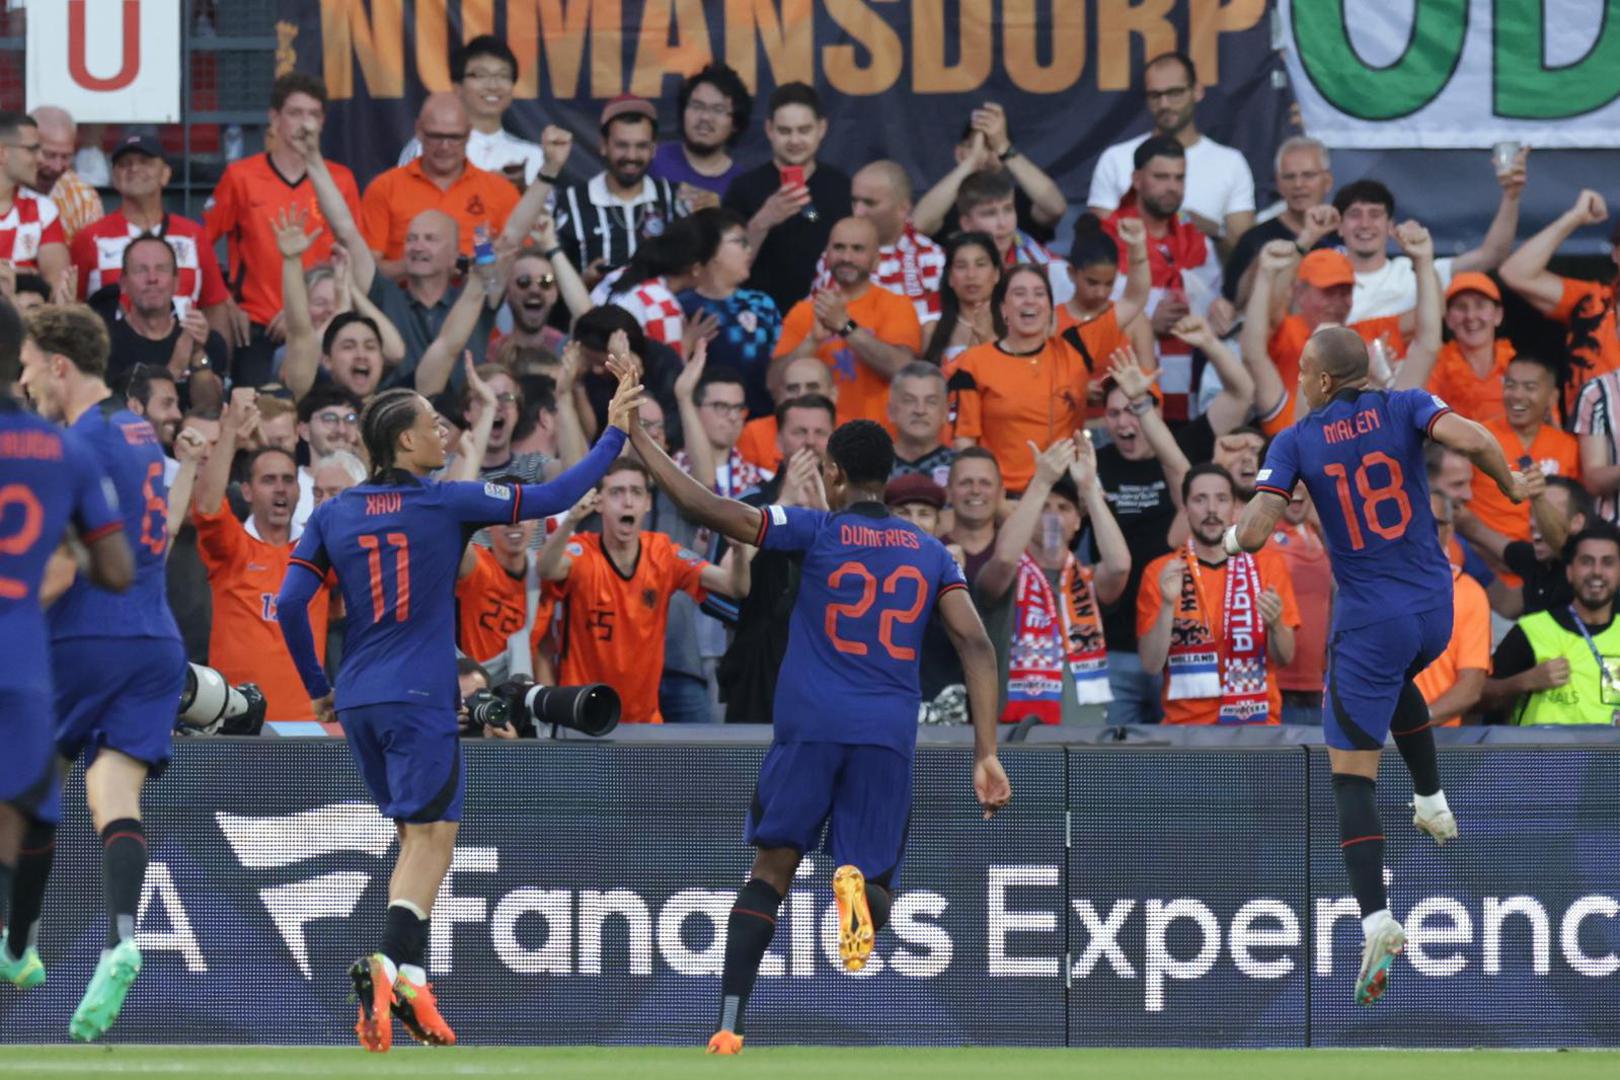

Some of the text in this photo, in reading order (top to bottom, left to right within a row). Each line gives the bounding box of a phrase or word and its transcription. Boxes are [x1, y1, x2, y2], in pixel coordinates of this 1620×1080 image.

[1323, 408, 1381, 445] MALEN
[366, 494, 402, 516] XAVI
[841, 524, 920, 549] DUMFRIES
[1324, 451, 1412, 551] 18
[358, 533, 410, 623] 11
[824, 561, 928, 660] 22
[430, 847, 954, 977] Fanaics
[988, 865, 1620, 1012] Experenc
